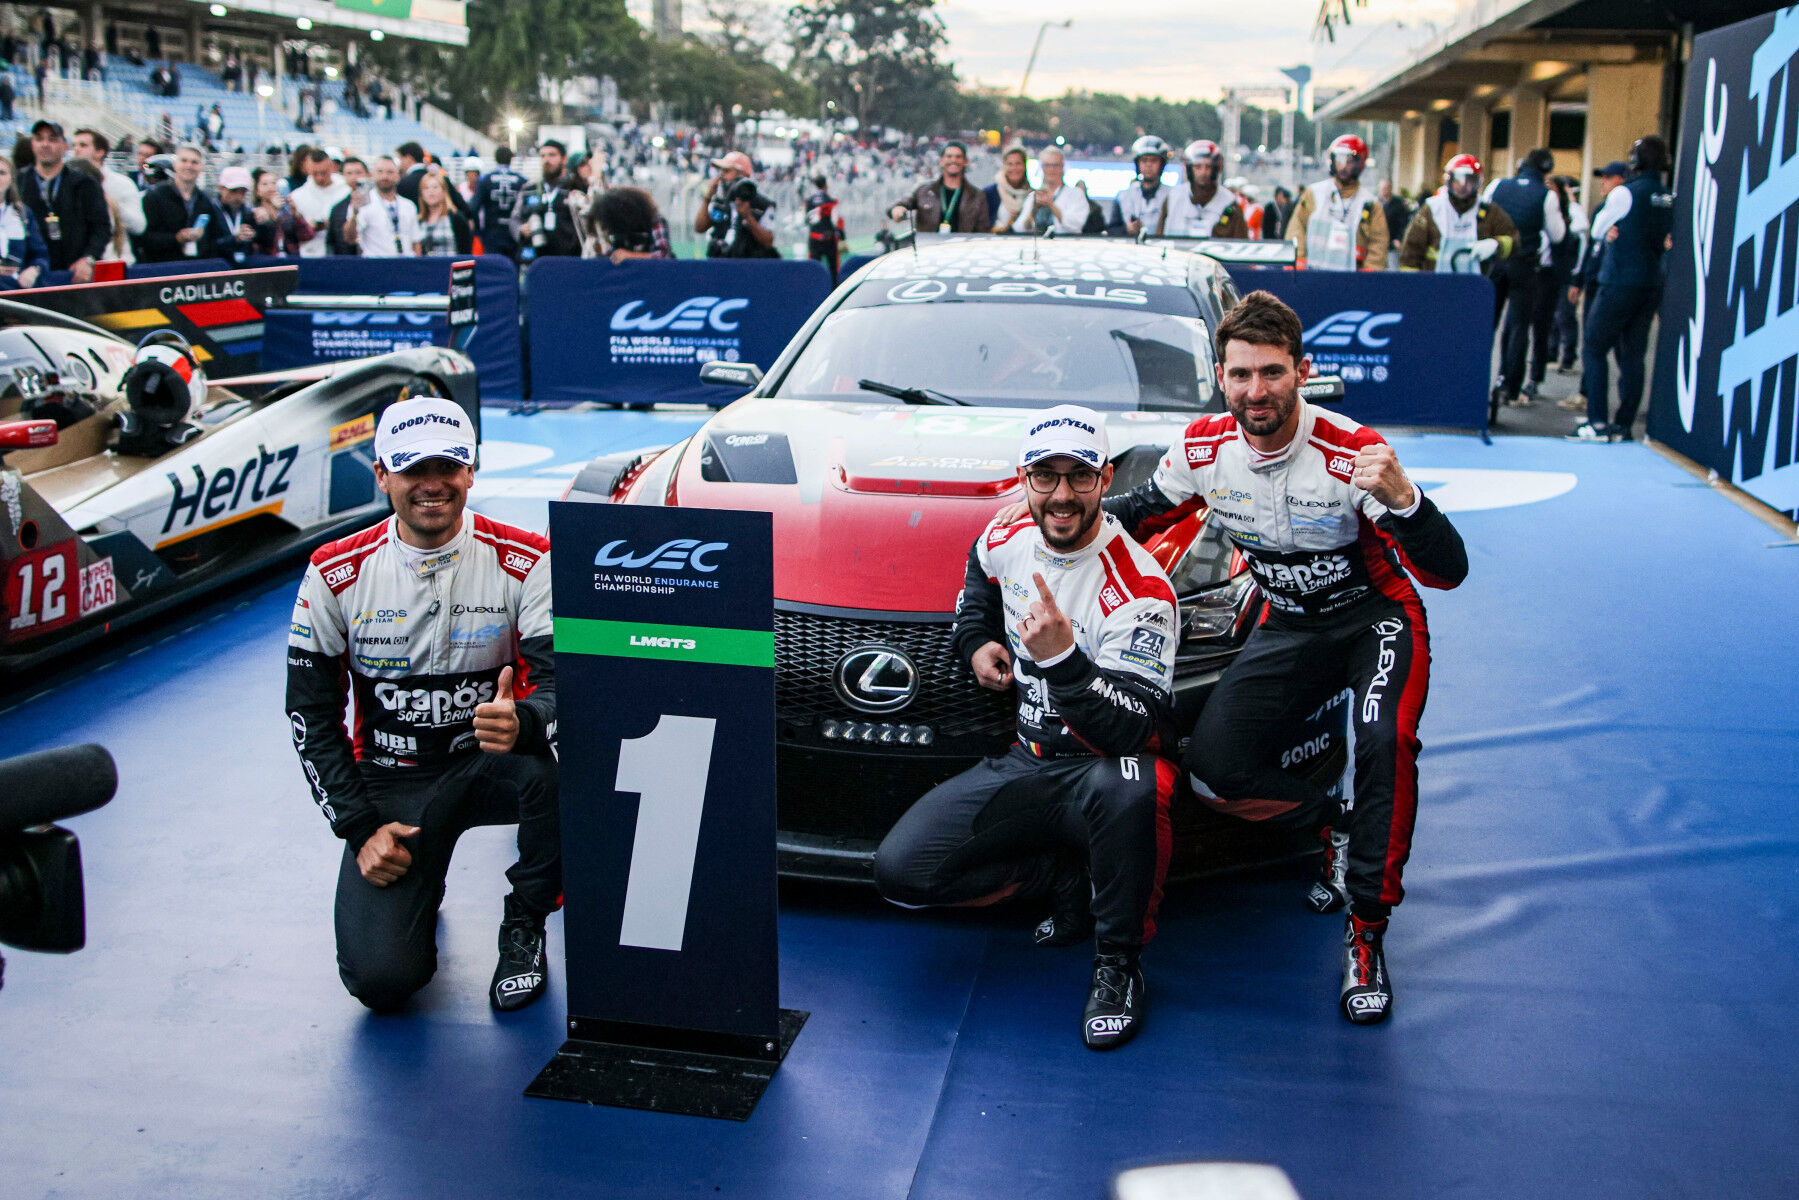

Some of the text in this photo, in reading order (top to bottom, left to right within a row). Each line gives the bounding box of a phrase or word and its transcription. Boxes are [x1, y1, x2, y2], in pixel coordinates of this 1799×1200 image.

[159, 280, 245, 304] CADILLAC
[955, 282, 1148, 305] LEXUS
[609, 296, 749, 332] WEC
[1316, 352, 1390, 363] ENDURANCE
[391, 413, 460, 434] GOODYEAR
[1030, 418, 1095, 436] GOODYEAR
[1187, 448, 1213, 459] OMP
[1329, 457, 1353, 474] OMP
[160, 444, 299, 534] Hertz
[505, 554, 532, 570] OMP
[594, 539, 729, 573] WEC
[81, 561, 113, 588] HYPER
[326, 565, 355, 585] OMP
[594, 574, 720, 589] FIA WORLD ENDURANCE
[1268, 567, 1352, 590] SOFT DRINKS
[10, 553, 66, 630] 12
[82, 578, 114, 612] CAR
[594, 583, 675, 594] CHAMPIONSHIP
[1102, 587, 1121, 607] OMP
[355, 637, 392, 646] MINERVA
[630, 636, 696, 650] LMGT3
[1134, 630, 1162, 653] 24h
[360, 657, 408, 668] GOODYEAR
[1122, 654, 1165, 672] GOODYEAR
[1363, 635, 1397, 724] LEXUS
[375, 679, 493, 725] Grapos
[397, 707, 476, 722] SOFT DRIN
[374, 729, 418, 751] HBI
[615, 714, 717, 952] 1
